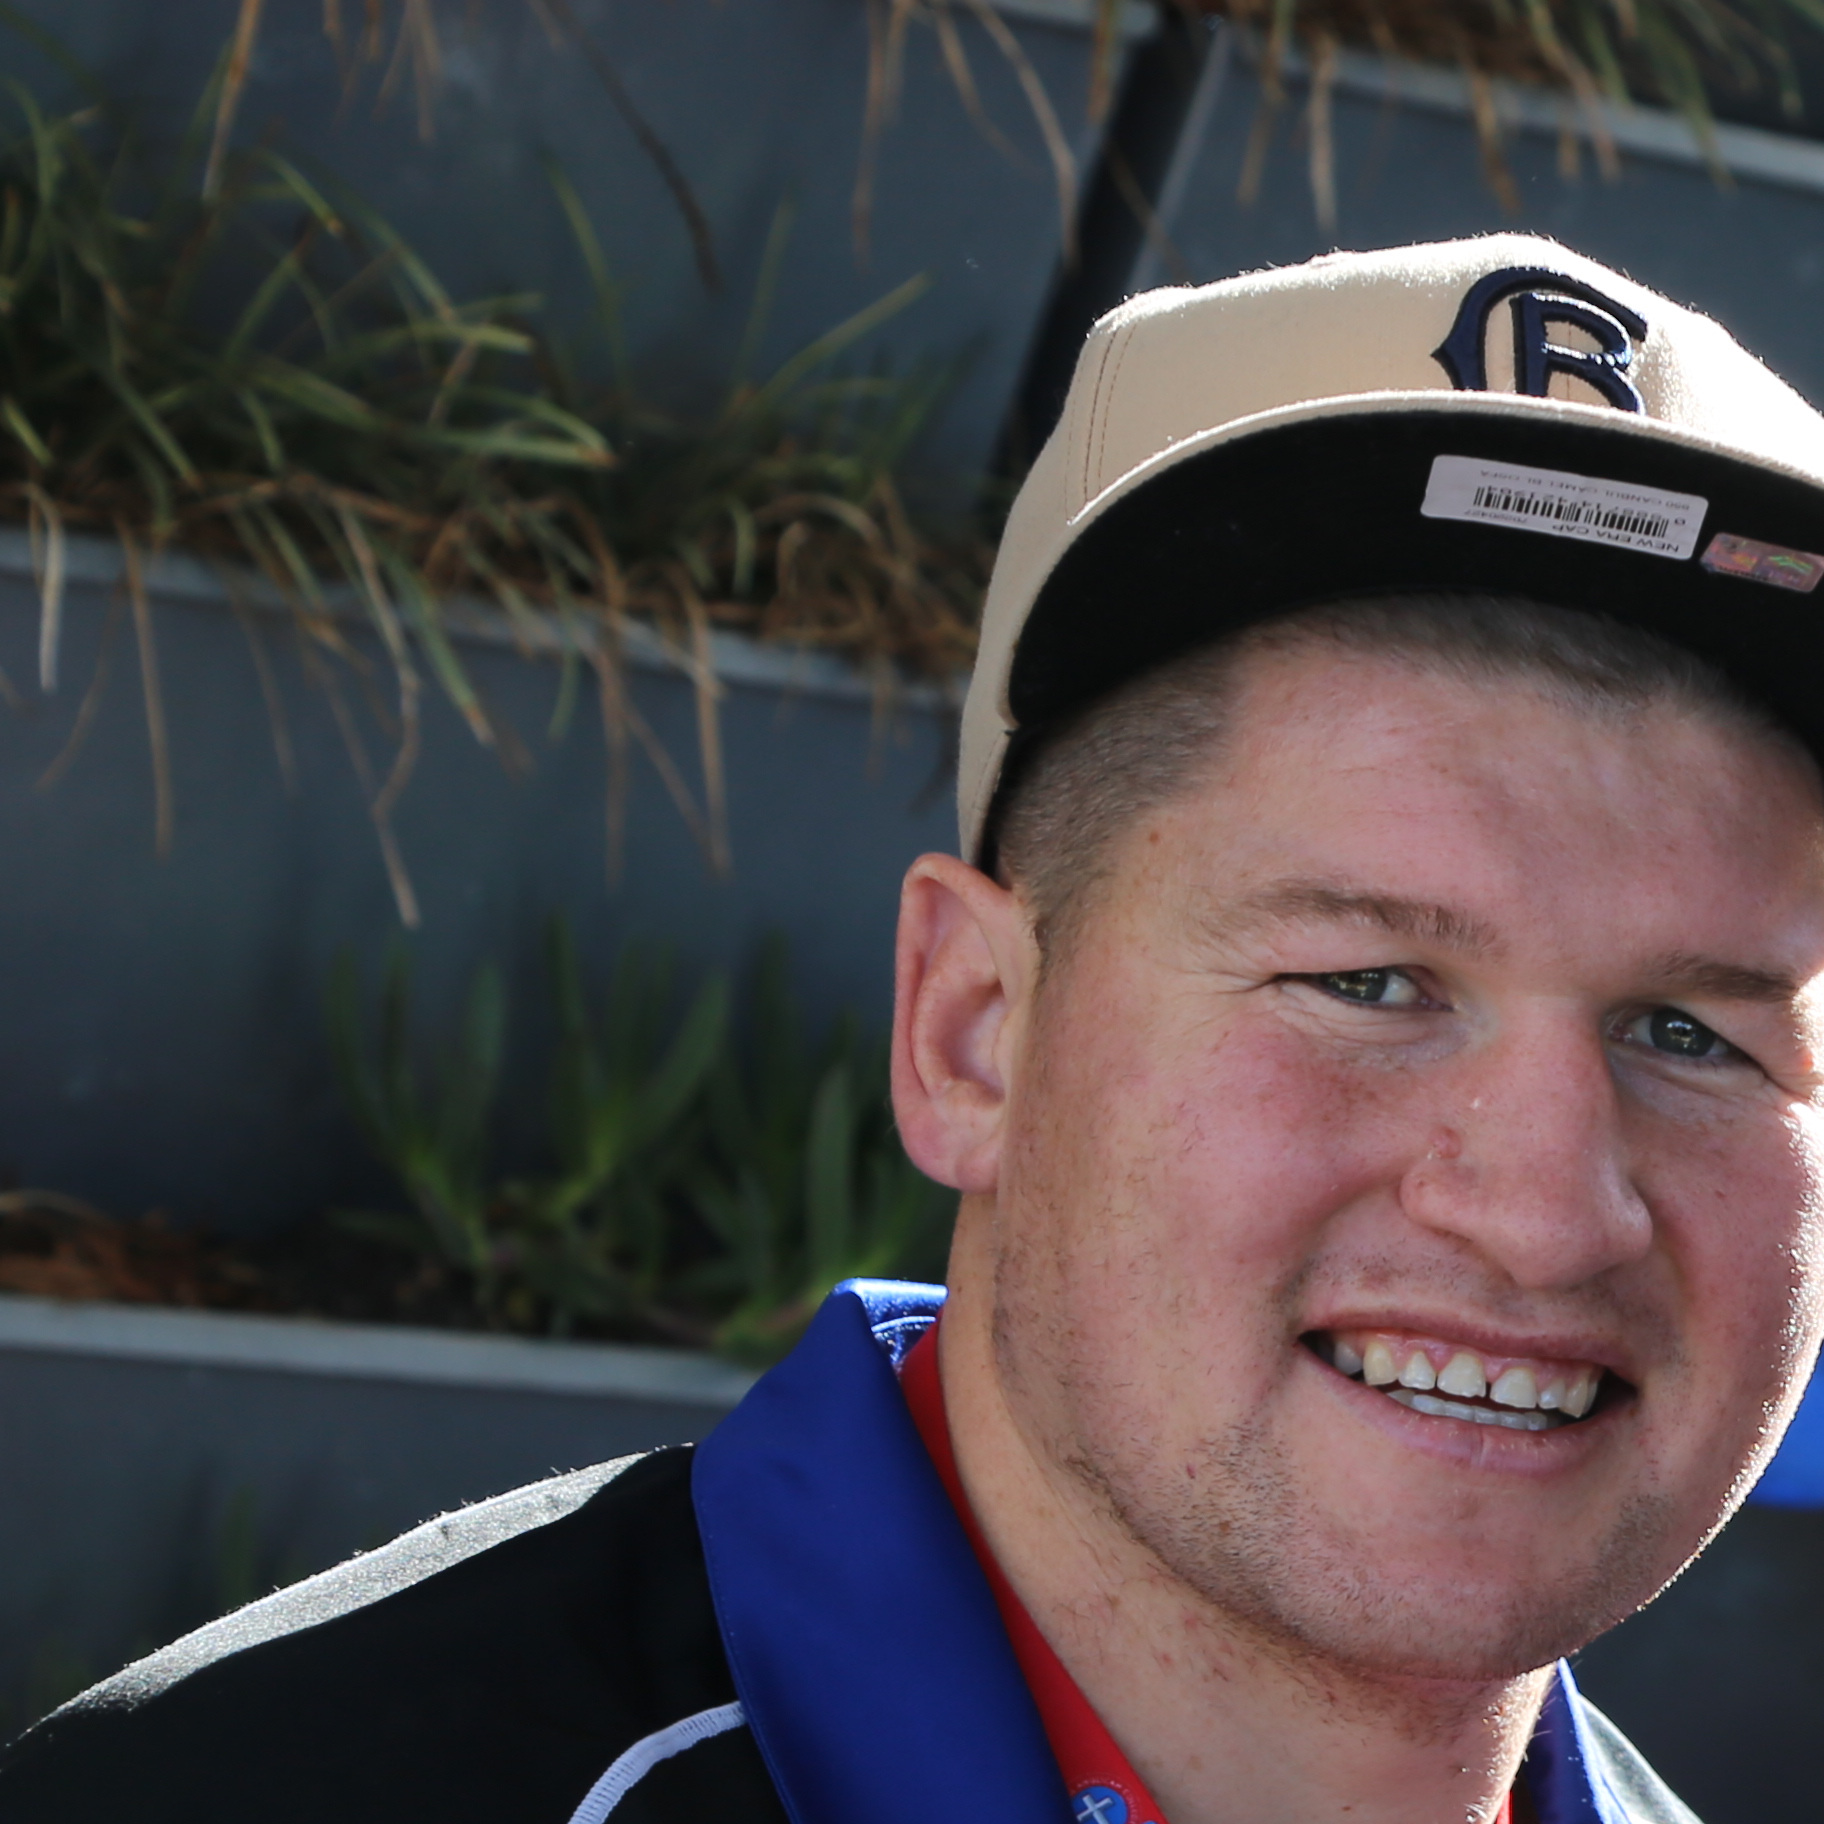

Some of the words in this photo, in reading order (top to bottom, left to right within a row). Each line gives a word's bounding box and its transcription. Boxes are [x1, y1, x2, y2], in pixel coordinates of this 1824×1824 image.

[1673, 516, 1686, 526] 0
[1550, 522, 1590, 536] CAP
[1594, 529, 1632, 543] ERA
[1635, 536, 1680, 552] NEW
